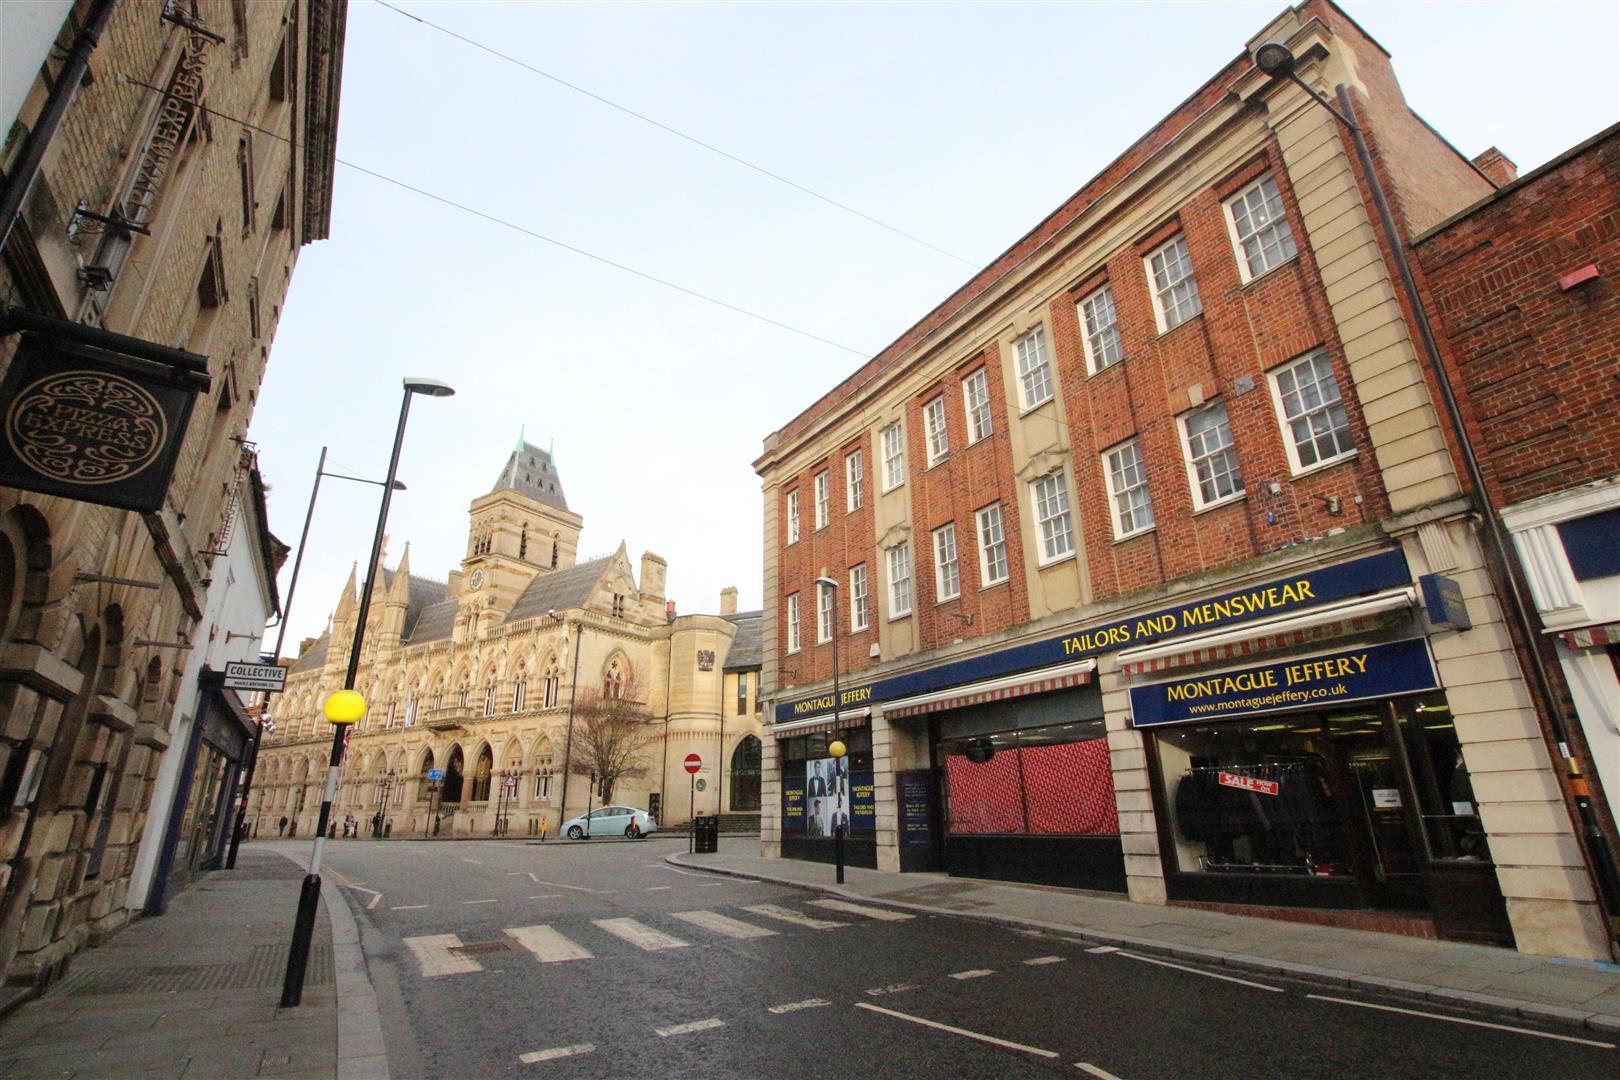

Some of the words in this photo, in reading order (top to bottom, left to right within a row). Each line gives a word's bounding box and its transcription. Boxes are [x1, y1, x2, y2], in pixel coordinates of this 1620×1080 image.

[24, 412, 147, 449] EXPRESS
[54, 403, 129, 431] PIZZA
[1062, 624, 1130, 655] TAILORS
[1135, 614, 1177, 639] AND
[1183, 580, 1315, 628] MENSWEAR
[230, 665, 283, 679] COLLECTIVE
[1167, 669, 1278, 702] MONTAGUE
[1285, 654, 1368, 686] JEFFERY
[840, 687, 872, 706] JEFFERY
[1188, 683, 1348, 714] www.montaguejeffery.co.uk
[1226, 772, 1254, 789] SALE
